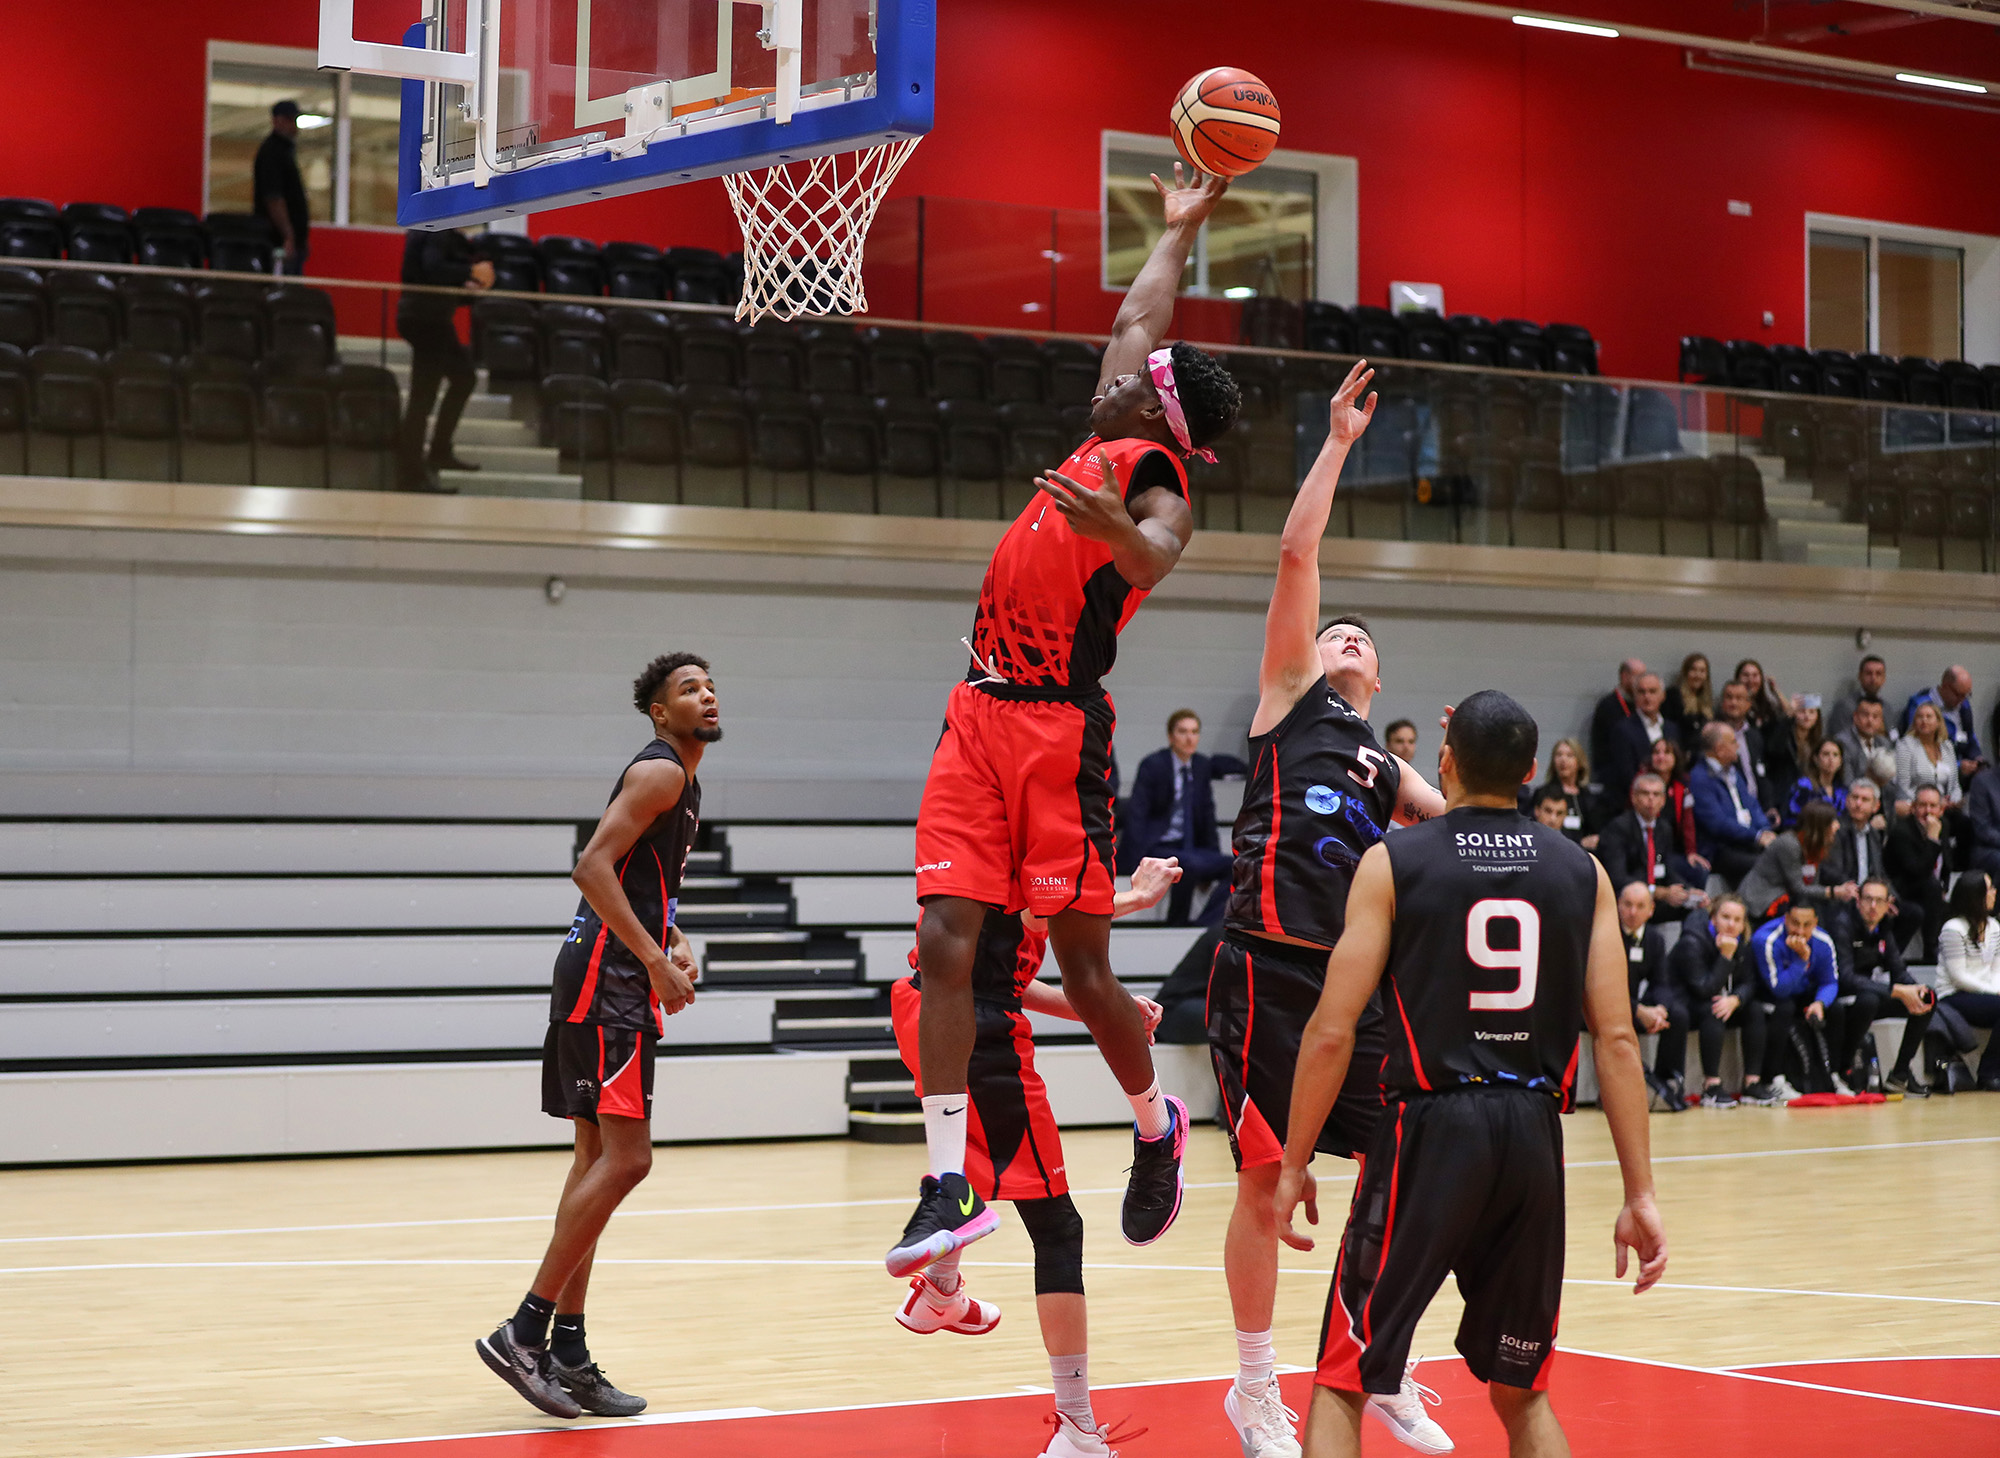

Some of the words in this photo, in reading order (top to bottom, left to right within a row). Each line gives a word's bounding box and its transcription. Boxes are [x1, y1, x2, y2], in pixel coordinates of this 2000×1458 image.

[1087, 454, 1119, 471] SOLT
[1346, 744, 1384, 789] 5
[1455, 832, 1534, 848] SOLENT
[1458, 848, 1538, 858] UNIVERSITY
[1030, 876, 1068, 886] SOLENT
[1465, 897, 1541, 1011] 9
[1500, 1334, 1541, 1351] SOLENT
